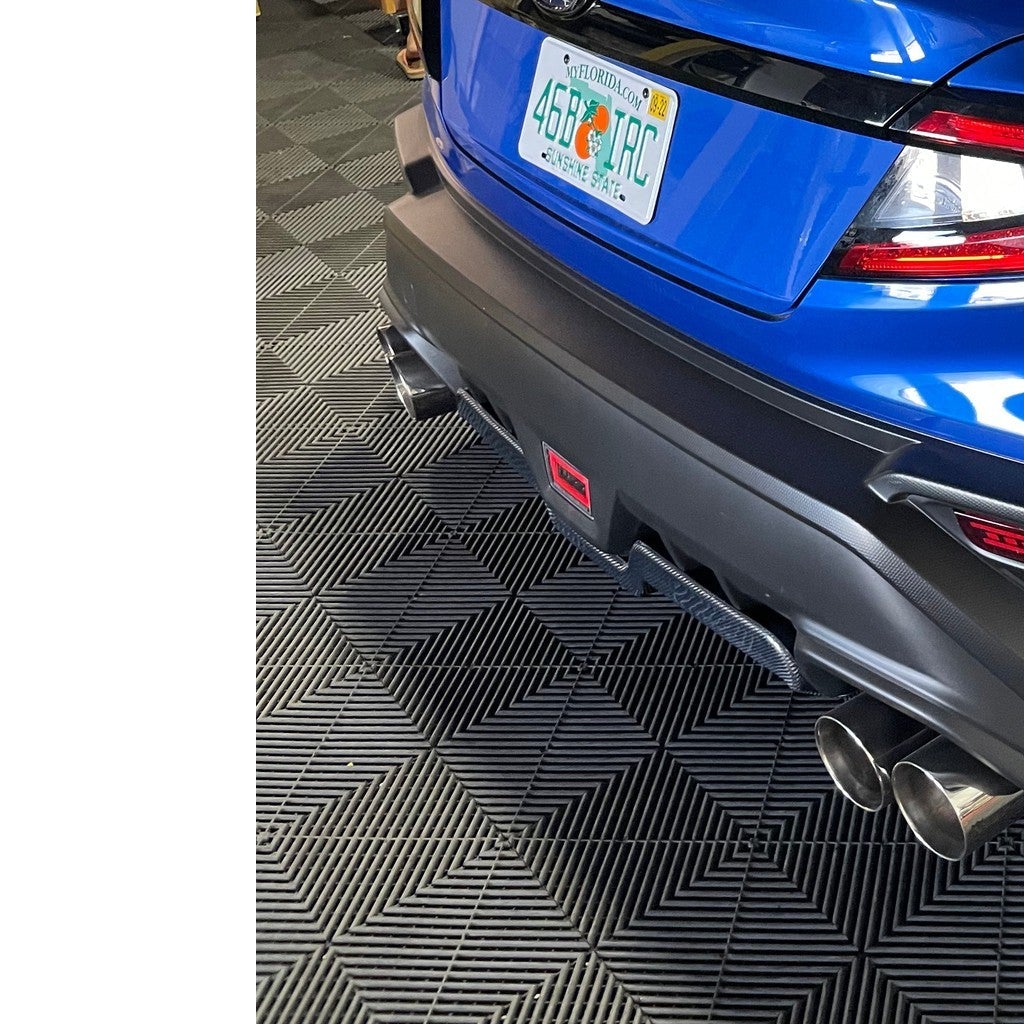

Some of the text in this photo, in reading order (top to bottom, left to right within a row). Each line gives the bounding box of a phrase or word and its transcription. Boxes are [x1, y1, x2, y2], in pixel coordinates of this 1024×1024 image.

[566, 63, 643, 112] MYFLORIDA.COM
[533, 78, 658, 187] 46B IRC
[545, 147, 621, 201] SUNSHINE STATE
